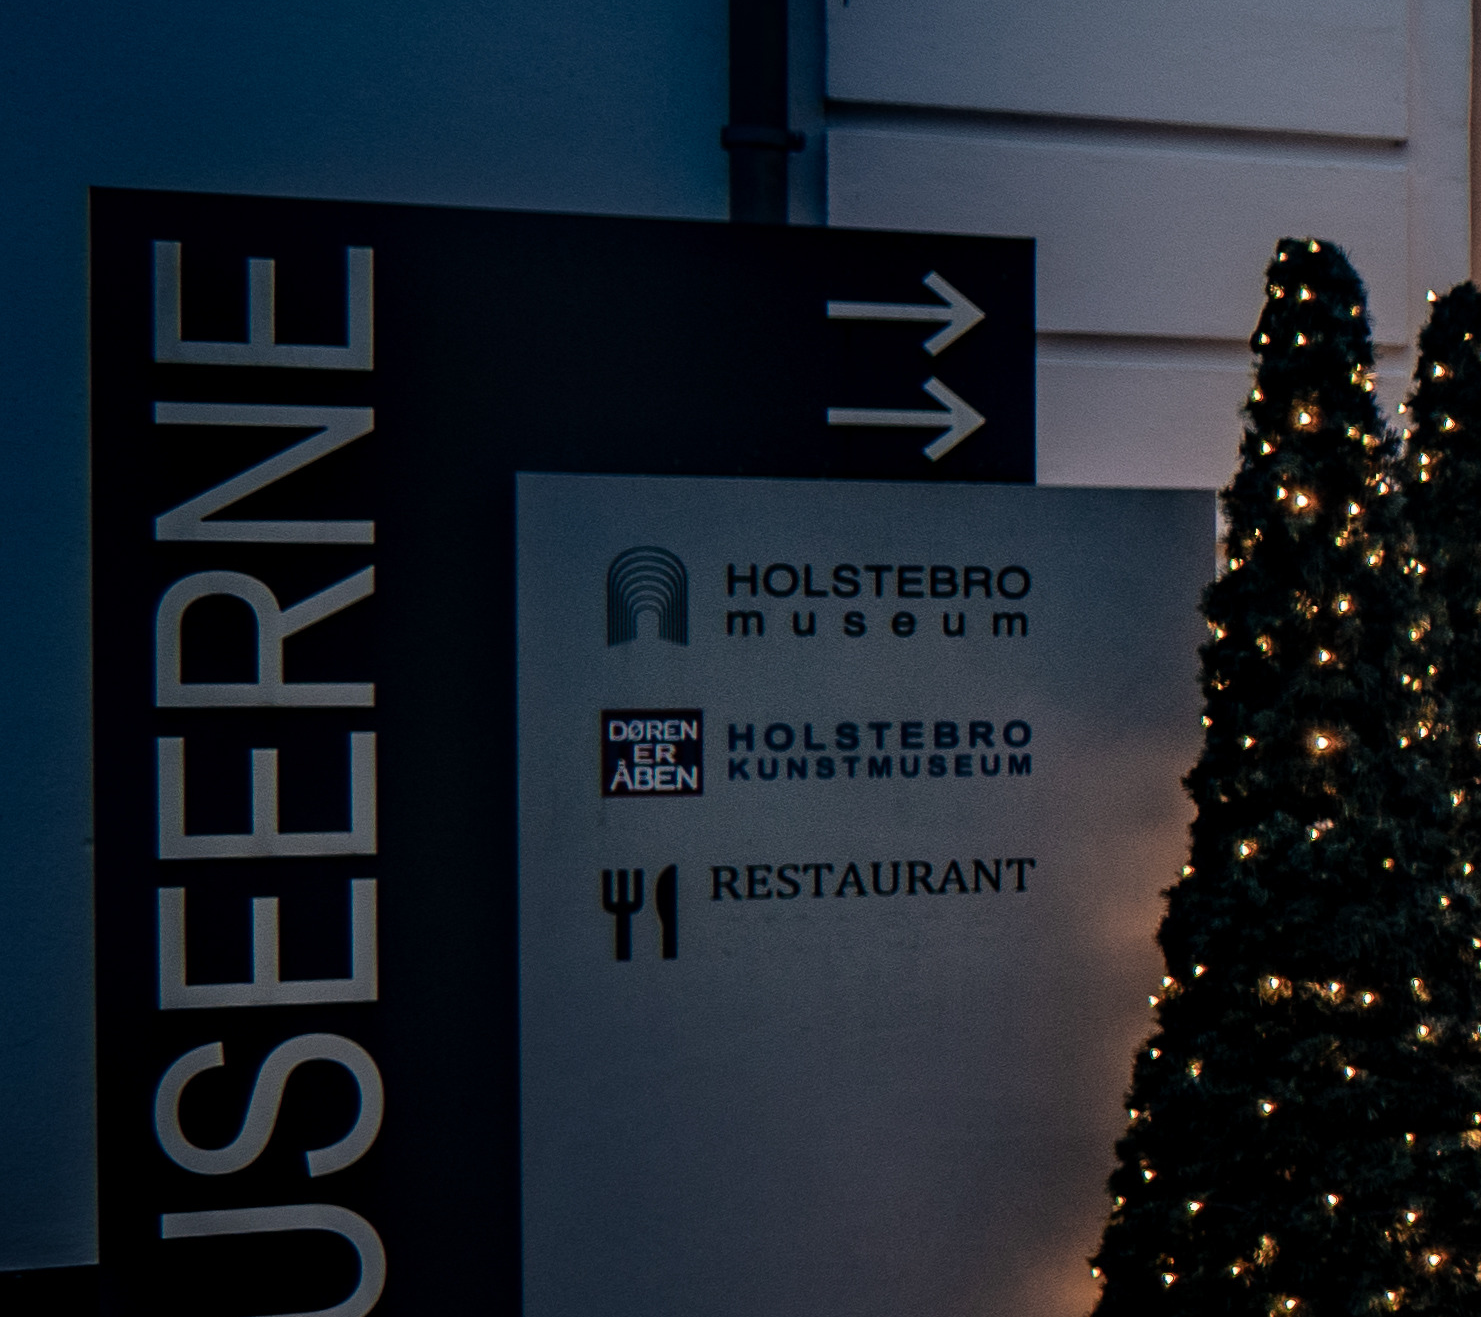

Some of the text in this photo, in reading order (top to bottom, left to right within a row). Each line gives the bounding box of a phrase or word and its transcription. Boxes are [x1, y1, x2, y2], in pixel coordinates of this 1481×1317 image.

[726, 563, 1032, 600] HOLSTEBRO
[727, 610, 1029, 638] museum
[608, 718, 698, 742] DØREN
[728, 720, 1032, 752] HOLSTEBRO
[632, 743, 677, 764] ER
[728, 753, 1032, 781] KUNSTMUSEUM
[609, 758, 698, 792] ÅBEN
[710, 857, 1037, 902] RESTAURANT
